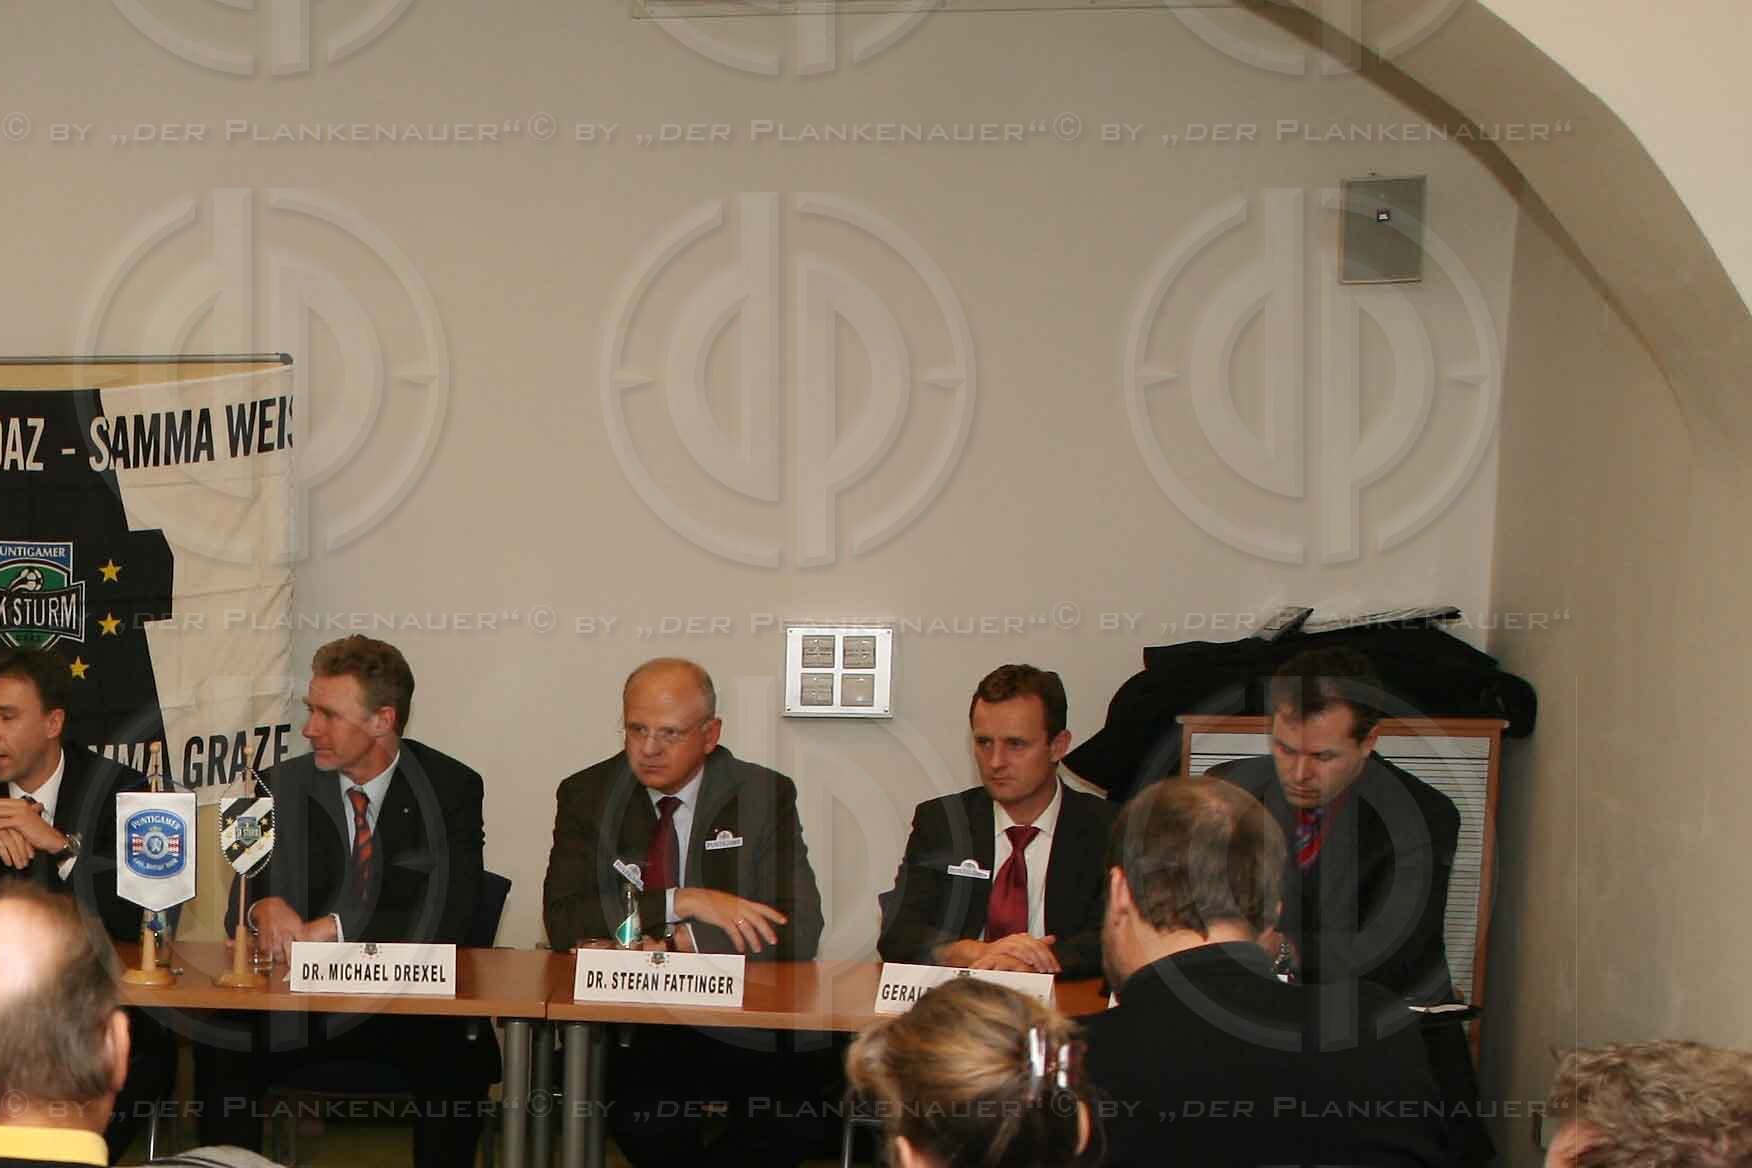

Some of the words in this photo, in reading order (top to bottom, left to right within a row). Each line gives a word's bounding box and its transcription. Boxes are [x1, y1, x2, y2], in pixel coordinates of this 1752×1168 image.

[88, 407, 215, 472] SAMMA
[13, 593, 77, 630] STURM
[302, 963, 324, 981] DR.
[329, 964, 388, 982] MICHAEL
[394, 965, 446, 983] DREXEL
[586, 970, 607, 989] DR.
[612, 971, 660, 992] STEFAN
[664, 975, 734, 995] FATTINGER
[882, 984, 935, 1001] GERAL
